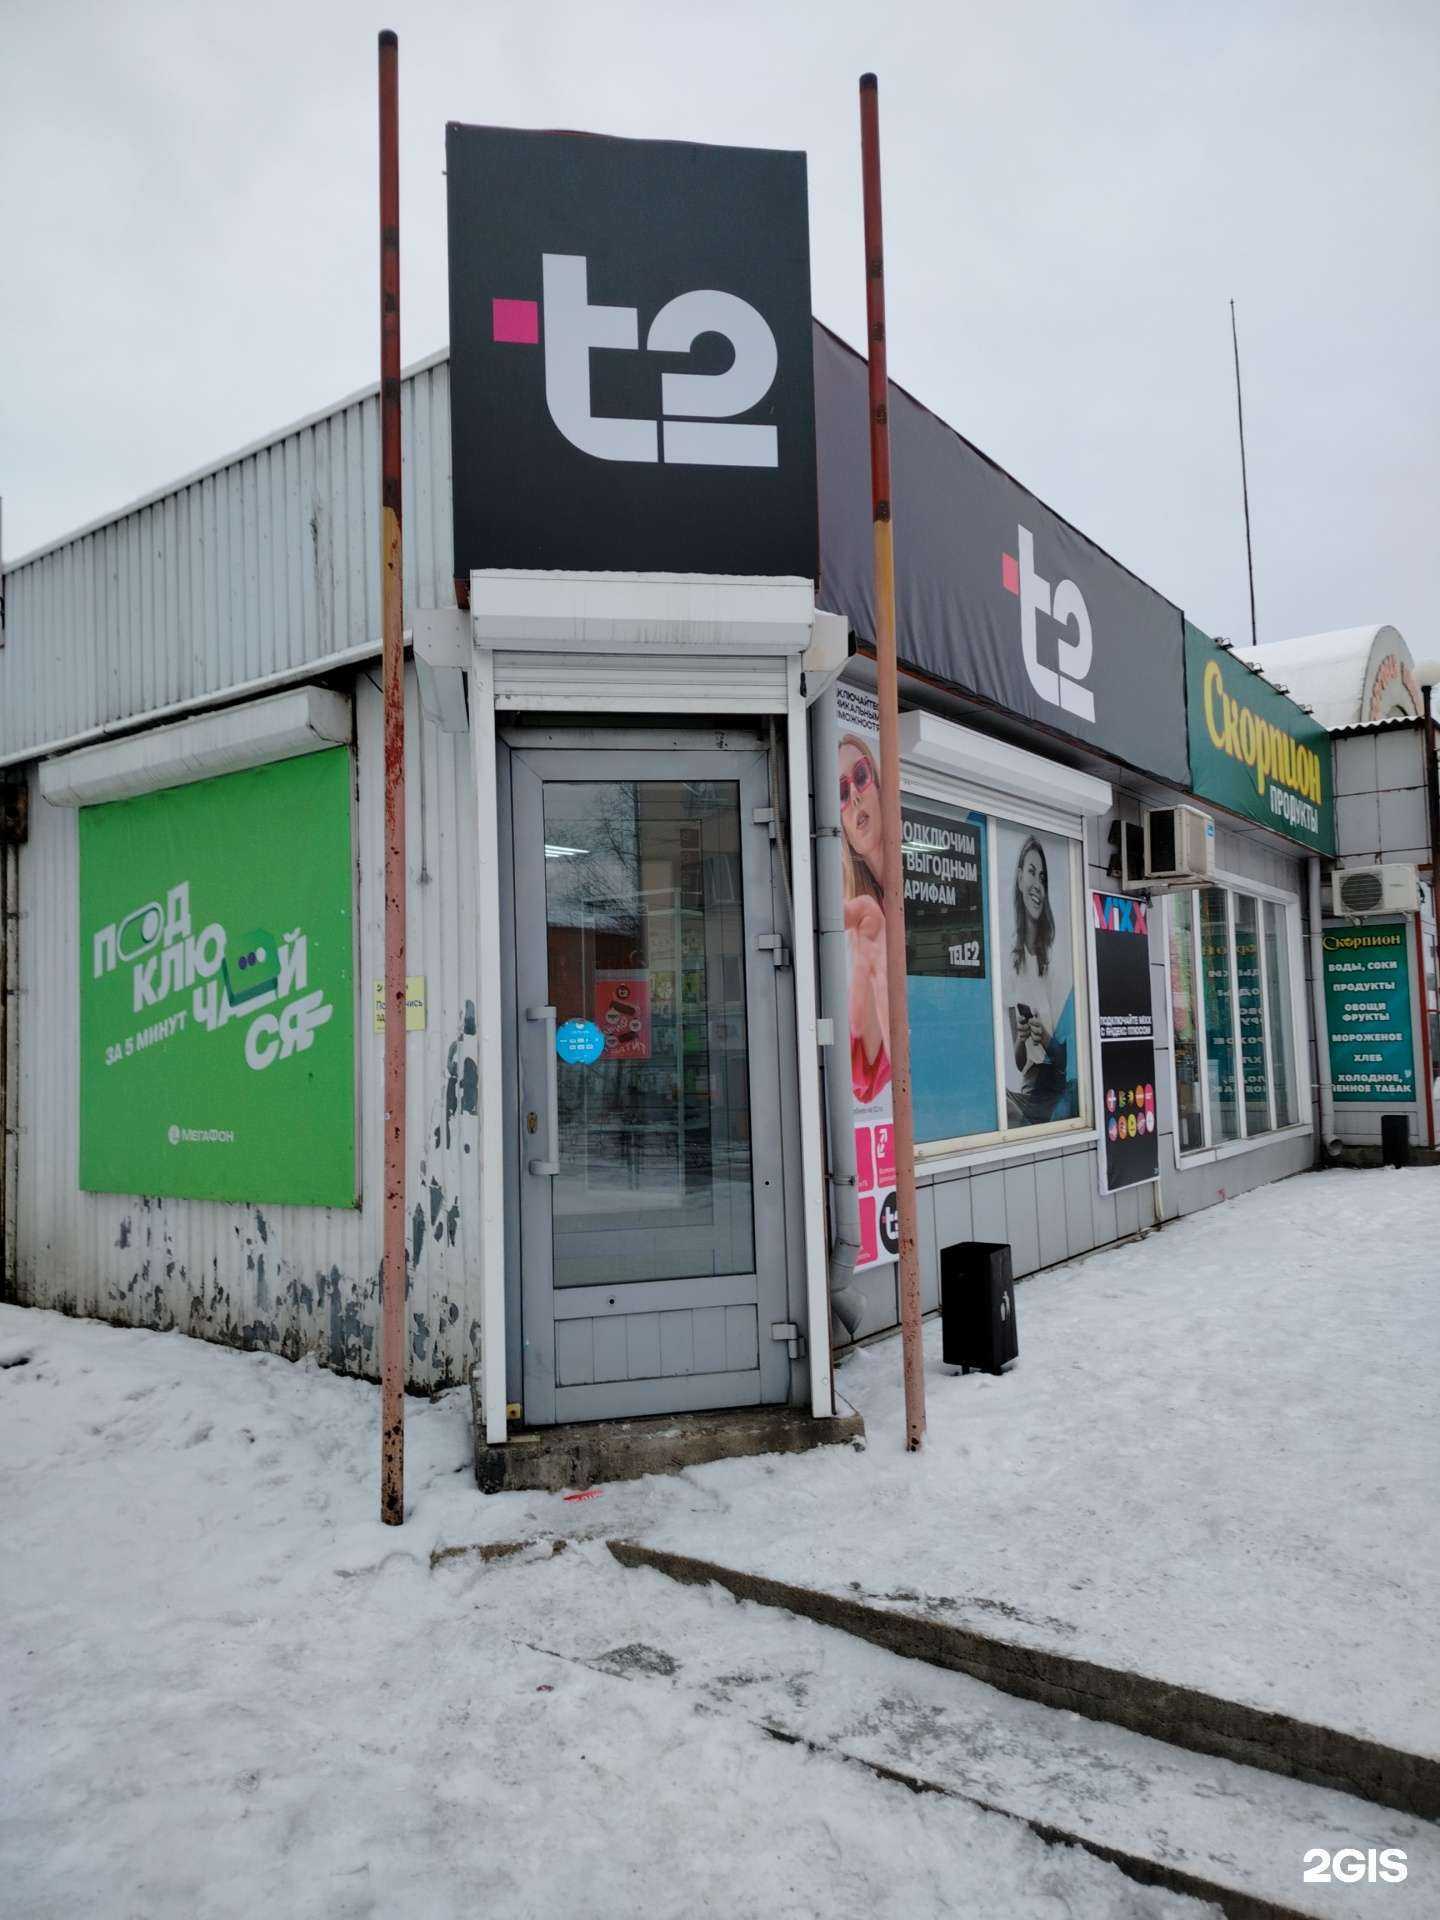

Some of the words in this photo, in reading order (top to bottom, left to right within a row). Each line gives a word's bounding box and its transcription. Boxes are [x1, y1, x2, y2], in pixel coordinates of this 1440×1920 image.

[542, 252, 779, 469] t2
[1018, 523, 1096, 724] t2
[1203, 660, 1323, 806] Скорпион
[1269, 784, 1320, 834] ПРОДУКТЫ
[901, 820, 976, 856] ОДКЛЮЧИМ
[906, 852, 978, 882] ВЫГОДНЫМ
[903, 879, 957, 906] АРИФАМ
[93, 879, 192, 980] ПОД
[1322, 935, 1402, 951] Скорпион
[948, 940, 981, 967] TELE2
[1367, 961, 1398, 970] СОКИ
[132, 922, 228, 1014] КЛЮ
[1332, 981, 1396, 992] ПРОДУКТЫ
[1342, 1013, 1390, 1022] ФРУКТЫ
[1344, 1002, 1387, 1012] ОВОЩИ
[105, 1042, 123, 1067] ЗА
[125, 1037, 134, 1057] 5
[136, 1009, 188, 1052] МИНУТ
[1331, 1033, 1403, 1042] МОРОЖЕНОЕ
[1353, 1054, 1383, 1062] ХЛЕБ
[1375, 1084, 1412, 1092] ТАБАК
[181, 1128, 235, 1142] МЕГАФОН
